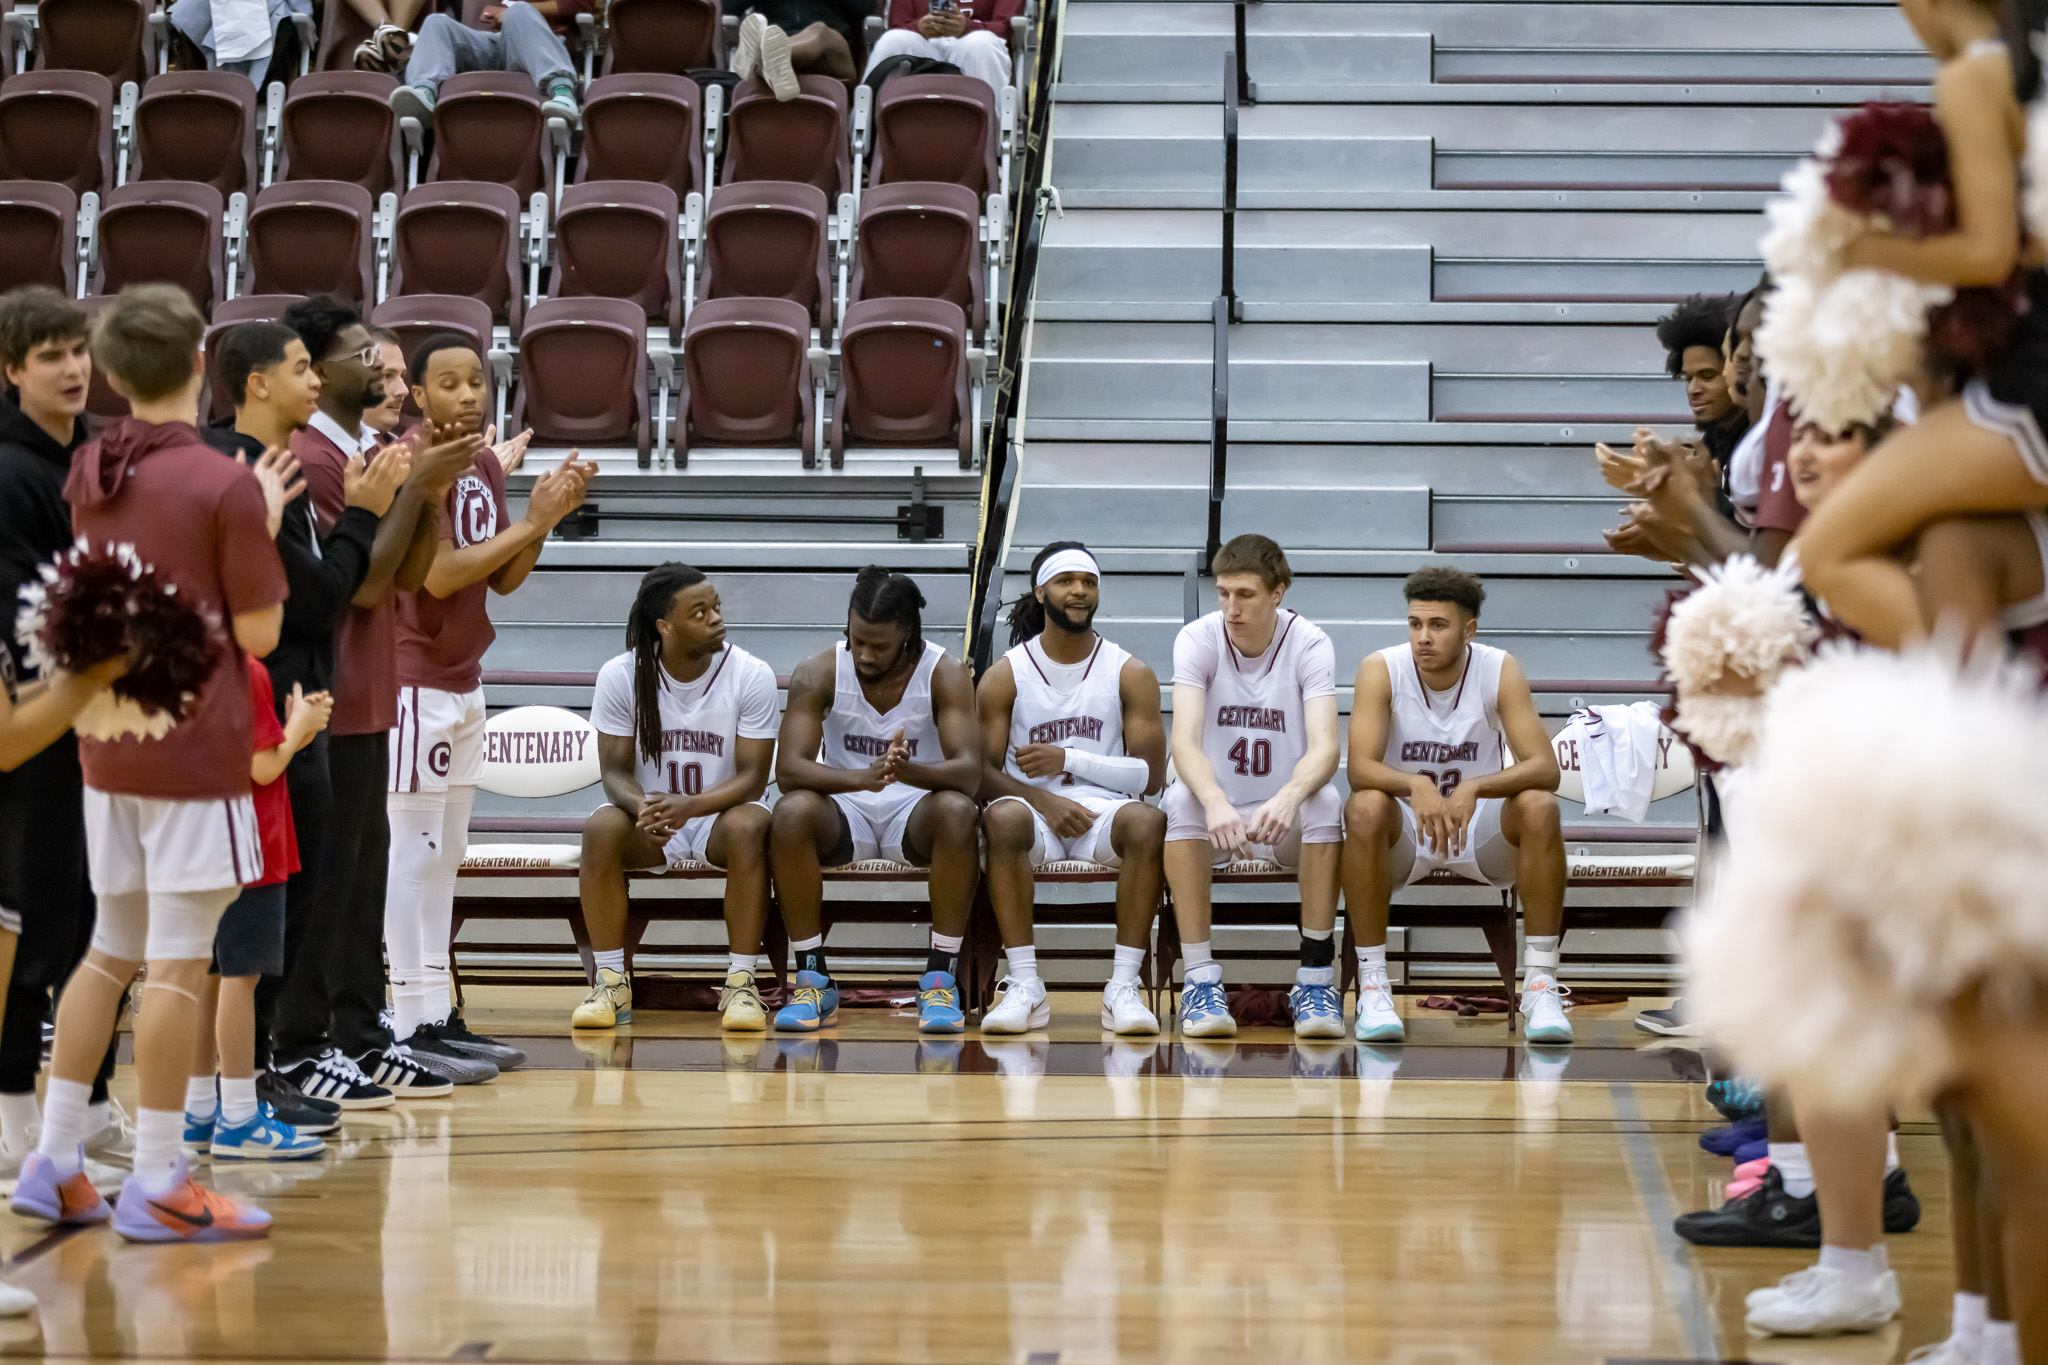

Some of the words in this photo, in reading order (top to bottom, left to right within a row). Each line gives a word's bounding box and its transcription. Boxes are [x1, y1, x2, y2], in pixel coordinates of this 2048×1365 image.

[1029, 715, 1104, 745] CENTENARY
[1217, 705, 1287, 734] CENTENARY
[483, 730, 590, 764] ENTENARY
[1228, 736, 1272, 777] 40
[1401, 741, 1480, 764] CENTENARY
[667, 760, 703, 796] 10
